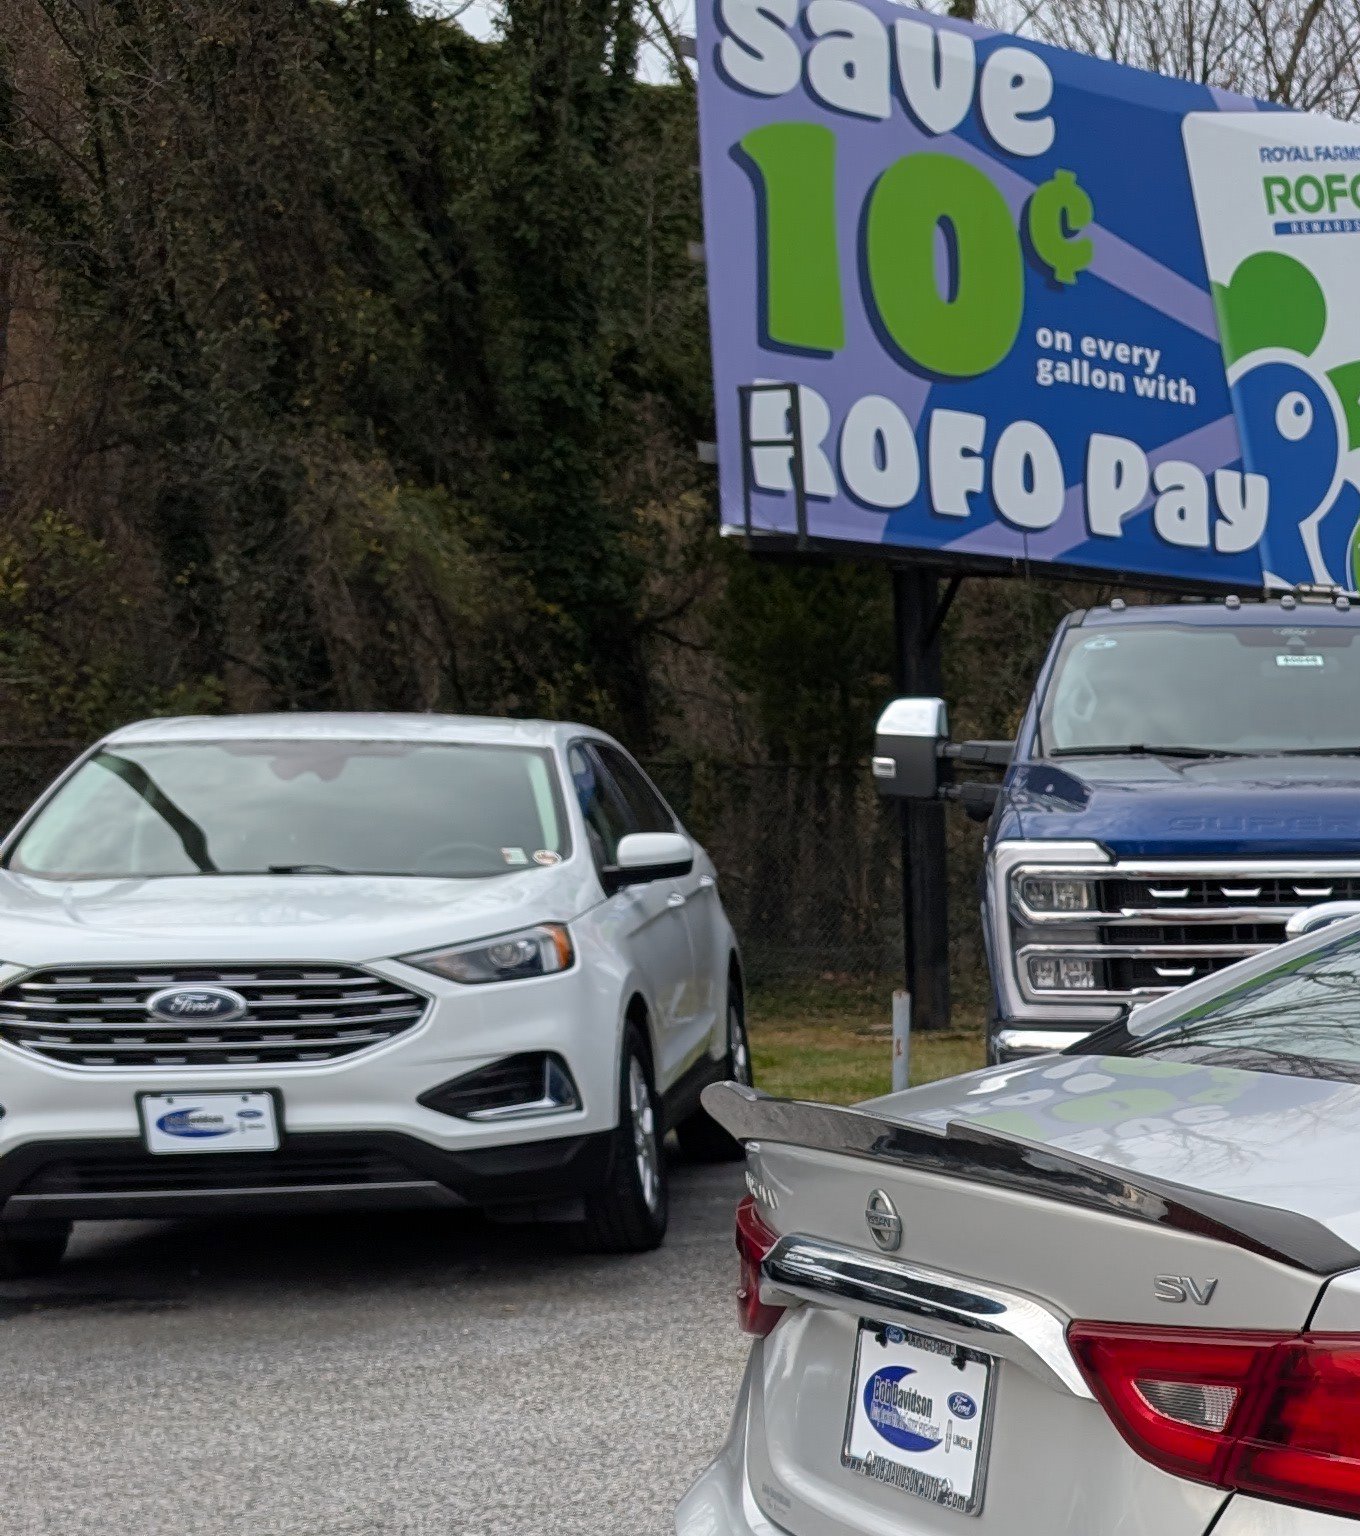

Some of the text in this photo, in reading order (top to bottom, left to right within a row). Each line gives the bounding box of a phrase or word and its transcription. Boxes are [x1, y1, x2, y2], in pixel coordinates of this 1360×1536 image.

[1259, 146, 1313, 163] ROYAL
[1036, 327, 1161, 375] on every
[1036, 358, 1197, 406] gallon with
[750, 379, 1269, 553] ROFO Pay
[1153, 1273, 1218, 1305] SV
[874, 1376, 933, 1419] Bob Davidson
[952, 1395, 972, 1416] Ford
